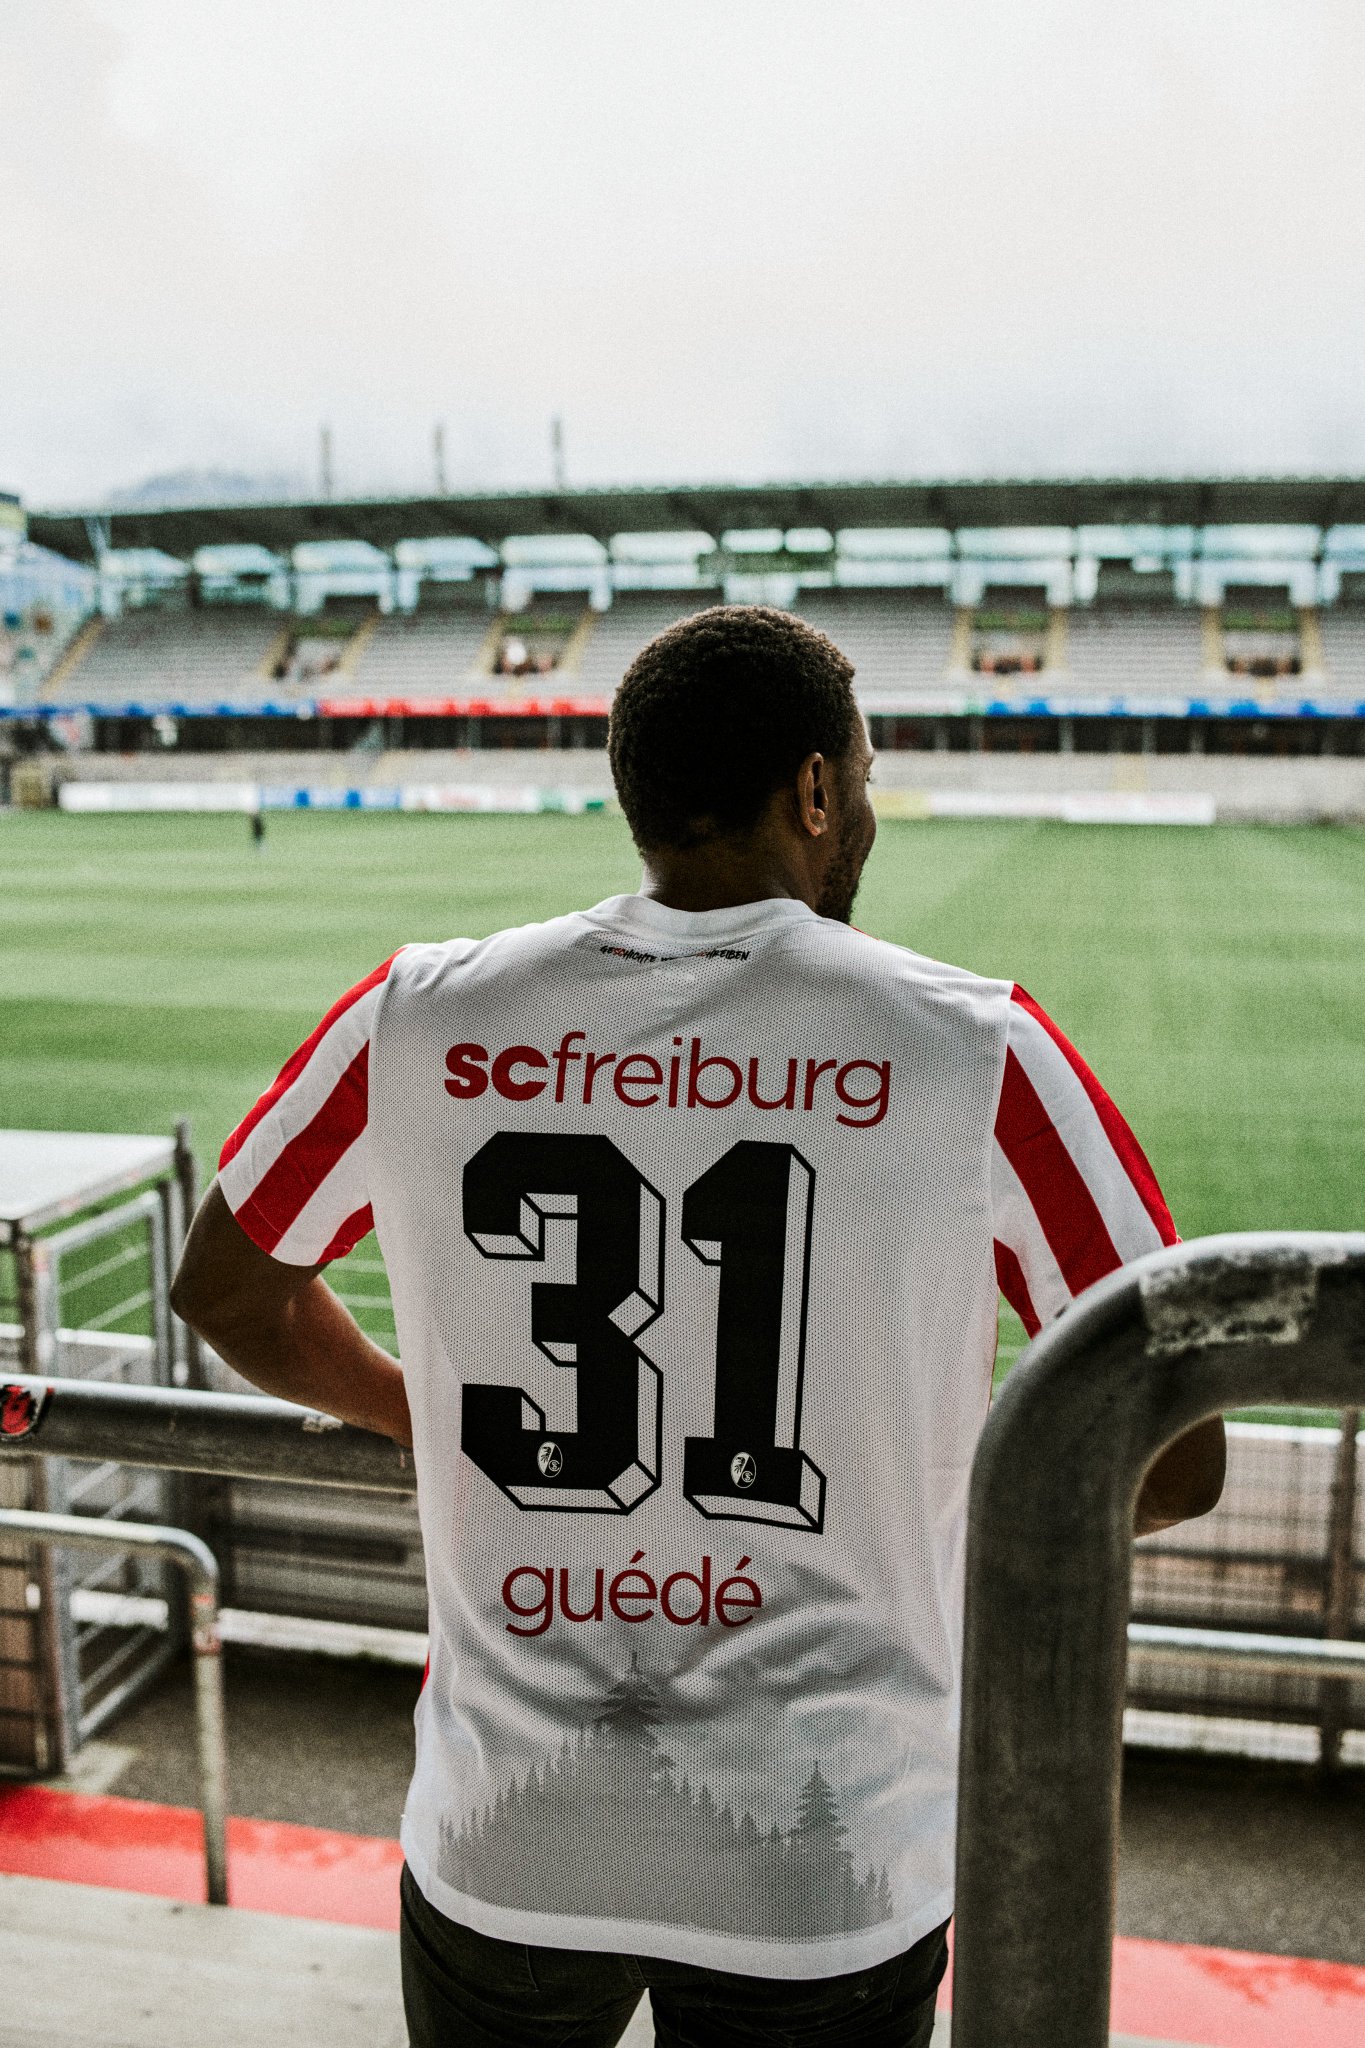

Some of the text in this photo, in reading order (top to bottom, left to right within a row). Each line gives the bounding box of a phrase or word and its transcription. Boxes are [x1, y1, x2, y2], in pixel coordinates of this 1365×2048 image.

[444, 1031, 891, 1128] scfreiburg
[461, 1131, 827, 1535] 31
[501, 1550, 763, 1637] guédé
